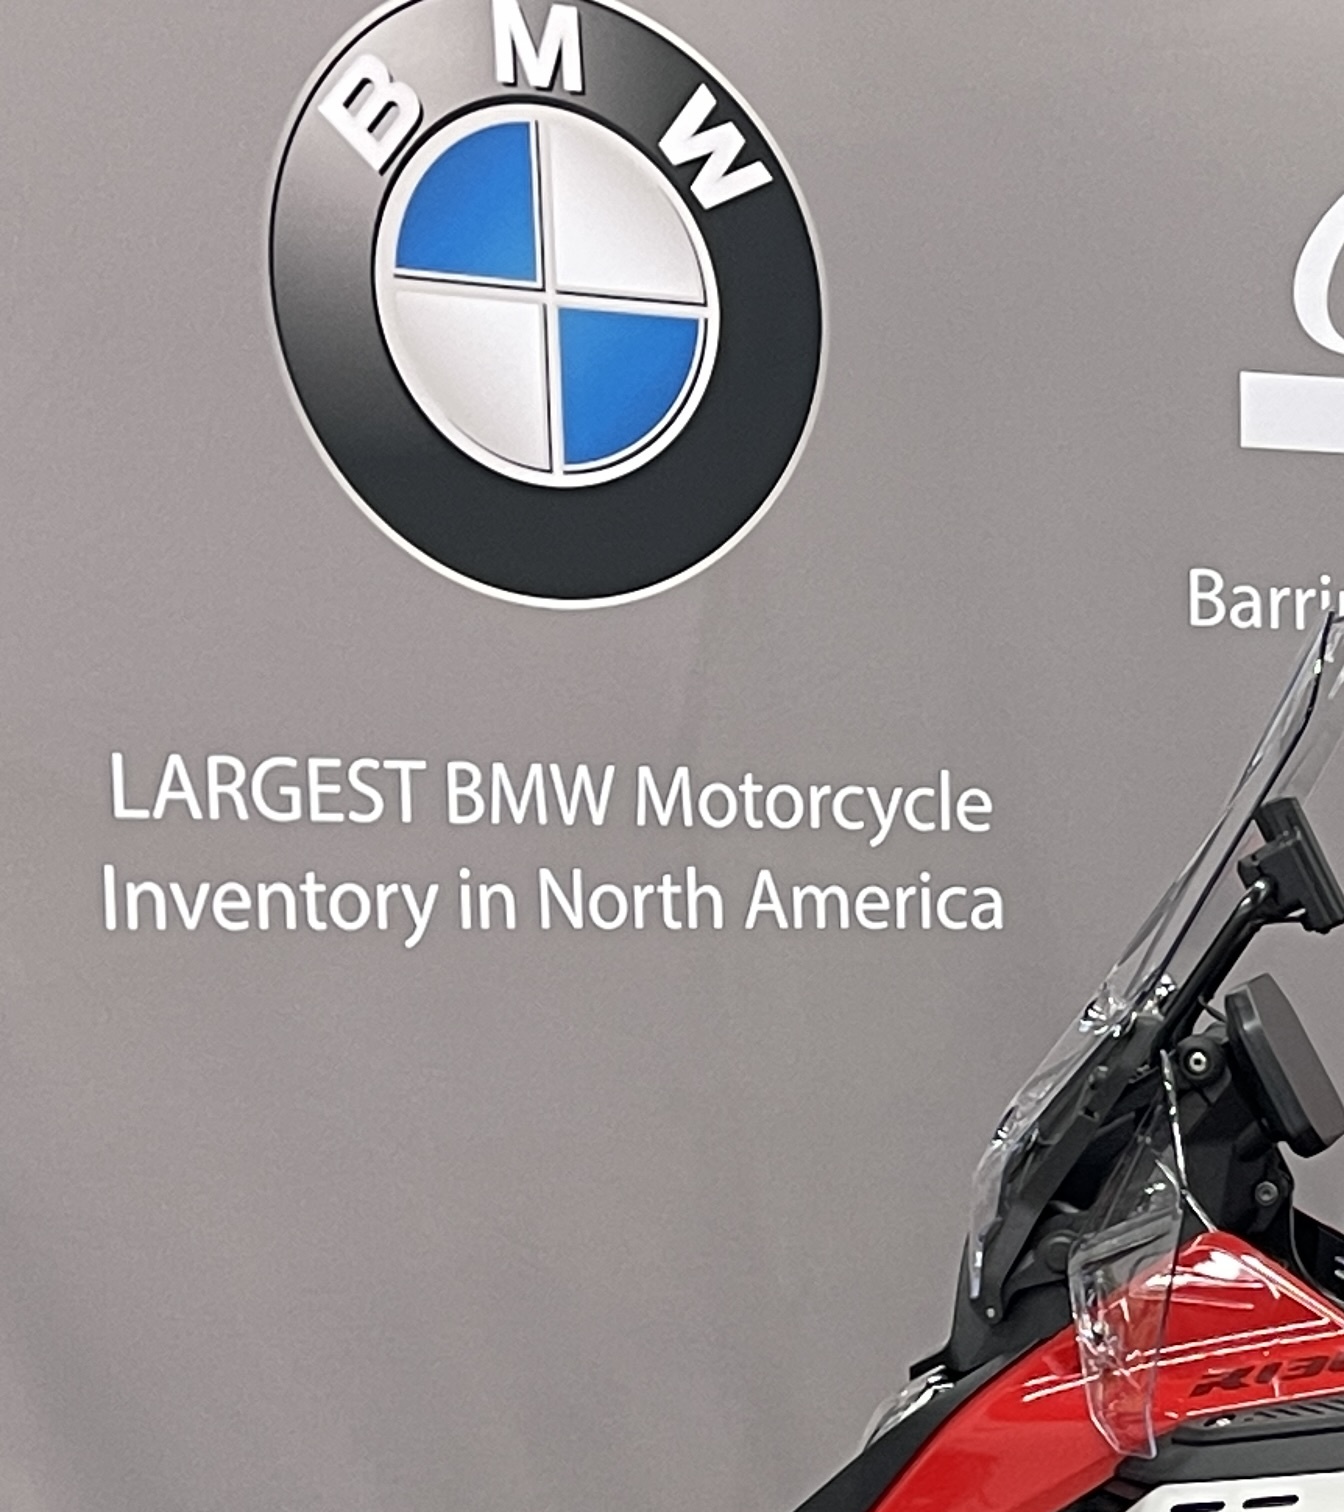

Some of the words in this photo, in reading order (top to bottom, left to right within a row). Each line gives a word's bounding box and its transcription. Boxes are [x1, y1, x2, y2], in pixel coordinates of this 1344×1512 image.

[318, 0, 774, 210] BMW
[110, 752, 427, 824] LARGEST
[446, 761, 616, 826] BMW
[636, 765, 994, 848] Motorcycle
[102, 864, 440, 950] Inventory
[458, 866, 517, 930] in
[538, 865, 724, 930] North
[744, 869, 1004, 930] America
